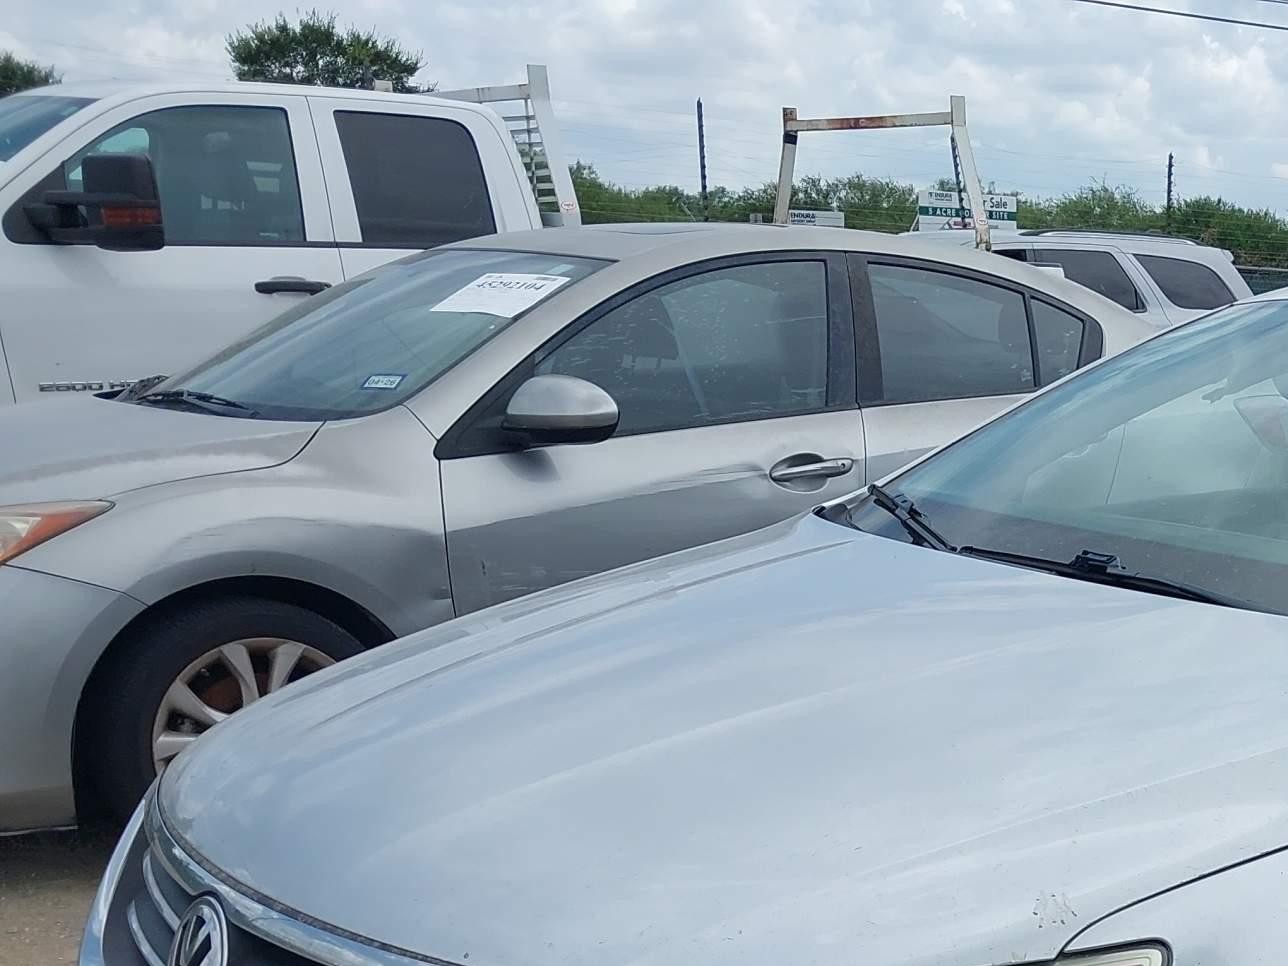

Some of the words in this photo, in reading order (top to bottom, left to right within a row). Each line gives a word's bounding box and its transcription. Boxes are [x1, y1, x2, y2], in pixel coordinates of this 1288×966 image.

[989, 197, 1008, 209] Sale
[936, 209, 957, 217] ACRE
[992, 212, 1009, 220] SITE
